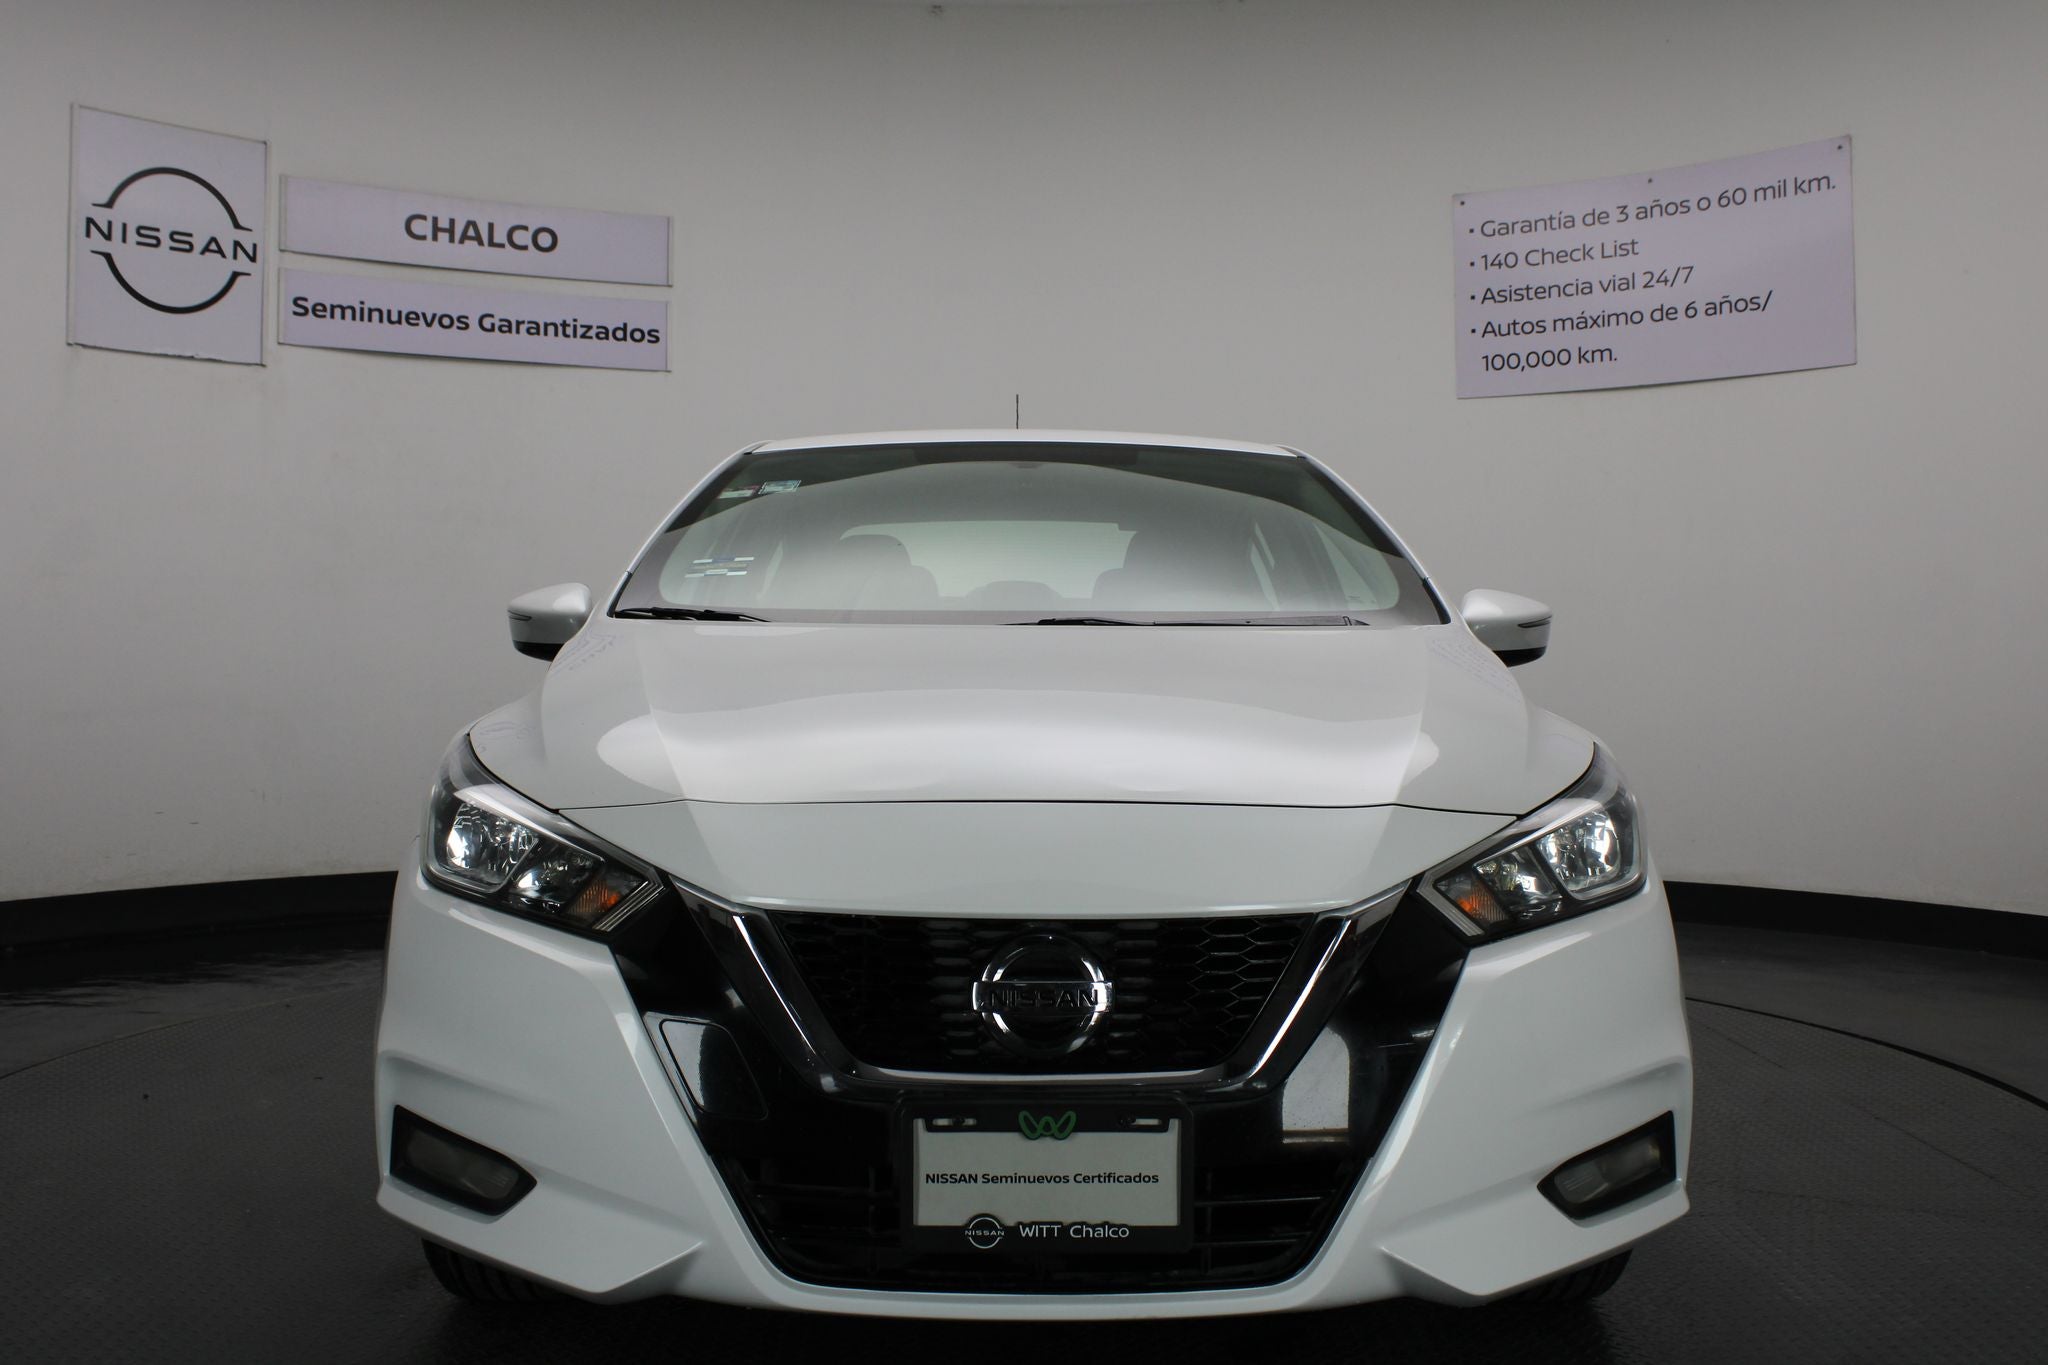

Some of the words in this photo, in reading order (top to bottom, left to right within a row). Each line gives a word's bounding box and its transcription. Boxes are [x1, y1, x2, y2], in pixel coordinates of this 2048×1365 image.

[1480, 210, 1576, 238] Garantía
[1582, 208, 1610, 227] de
[1616, 204, 1630, 223] 3
[1635, 199, 1691, 221] años
[1696, 196, 1712, 212] o
[1717, 187, 1747, 209] 60
[1753, 179, 1787, 203] mil
[1794, 175, 1836, 196] km.
[85, 216, 258, 264] NISSAN
[404, 213, 559, 253] CHALCO
[1480, 251, 1519, 271] 140
[1524, 243, 1595, 267] Check
[1601, 239, 1640, 259] List
[1480, 278, 1593, 305] Asistencia
[1598, 271, 1636, 293] vial
[1642, 265, 1694, 289] 24/7
[292, 296, 470, 331] Seminuevos
[477, 313, 661, 344] Garantizados
[1481, 319, 1547, 339] Autos
[1552, 310, 1644, 332] máximo
[1649, 303, 1679, 323] de
[1684, 300, 1698, 319] 6
[1704, 289, 1773, 317] años/
[1481, 348, 1572, 372] 100,000
[1578, 346, 1618, 365] km.
[925, 1173, 978, 1184] NISSAN
[981, 1172, 1070, 1184] Seminuevos
[1073, 1172, 1159, 1184] Certificados
[1019, 1224, 1062, 1238] WITT
[1069, 1223, 1131, 1238] Chalco
